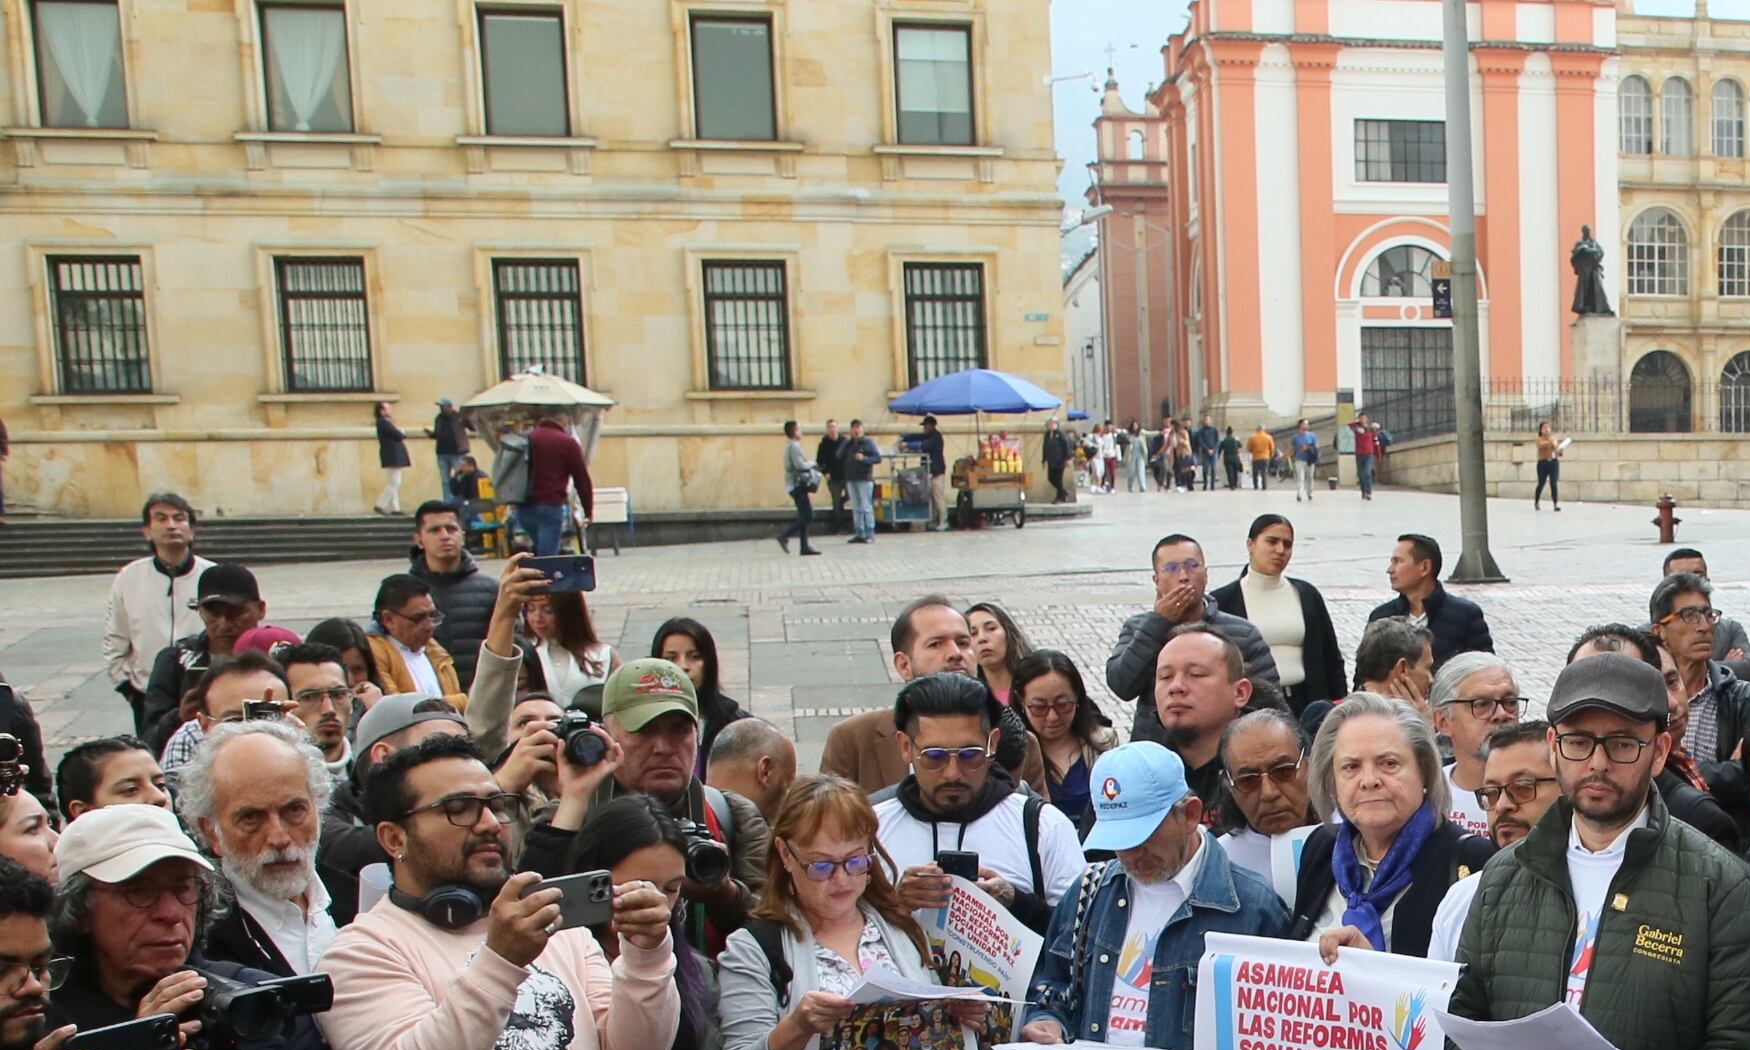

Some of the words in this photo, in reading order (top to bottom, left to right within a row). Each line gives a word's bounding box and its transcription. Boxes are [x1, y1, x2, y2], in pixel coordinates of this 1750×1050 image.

[952, 894, 994, 929] NACIONAL
[995, 925, 1009, 940] POR
[953, 887, 997, 922] ASAMBLEA
[951, 903, 967, 918] LAS
[969, 915, 1009, 951] REFORMAS
[954, 923, 965, 936] LA
[967, 931, 997, 958] UNIDAD
[1639, 925, 1682, 945] Gabriel
[992, 942, 1002, 954] LA
[1633, 947, 1681, 965] CONGRESISTA
[1635, 934, 1684, 958] Becerra
[1236, 960, 1344, 995] ASAMBLEA
[1237, 987, 1341, 1022] NACIONAL
[1349, 1001, 1383, 1030] POR
[1238, 1013, 1275, 1039] LAS
